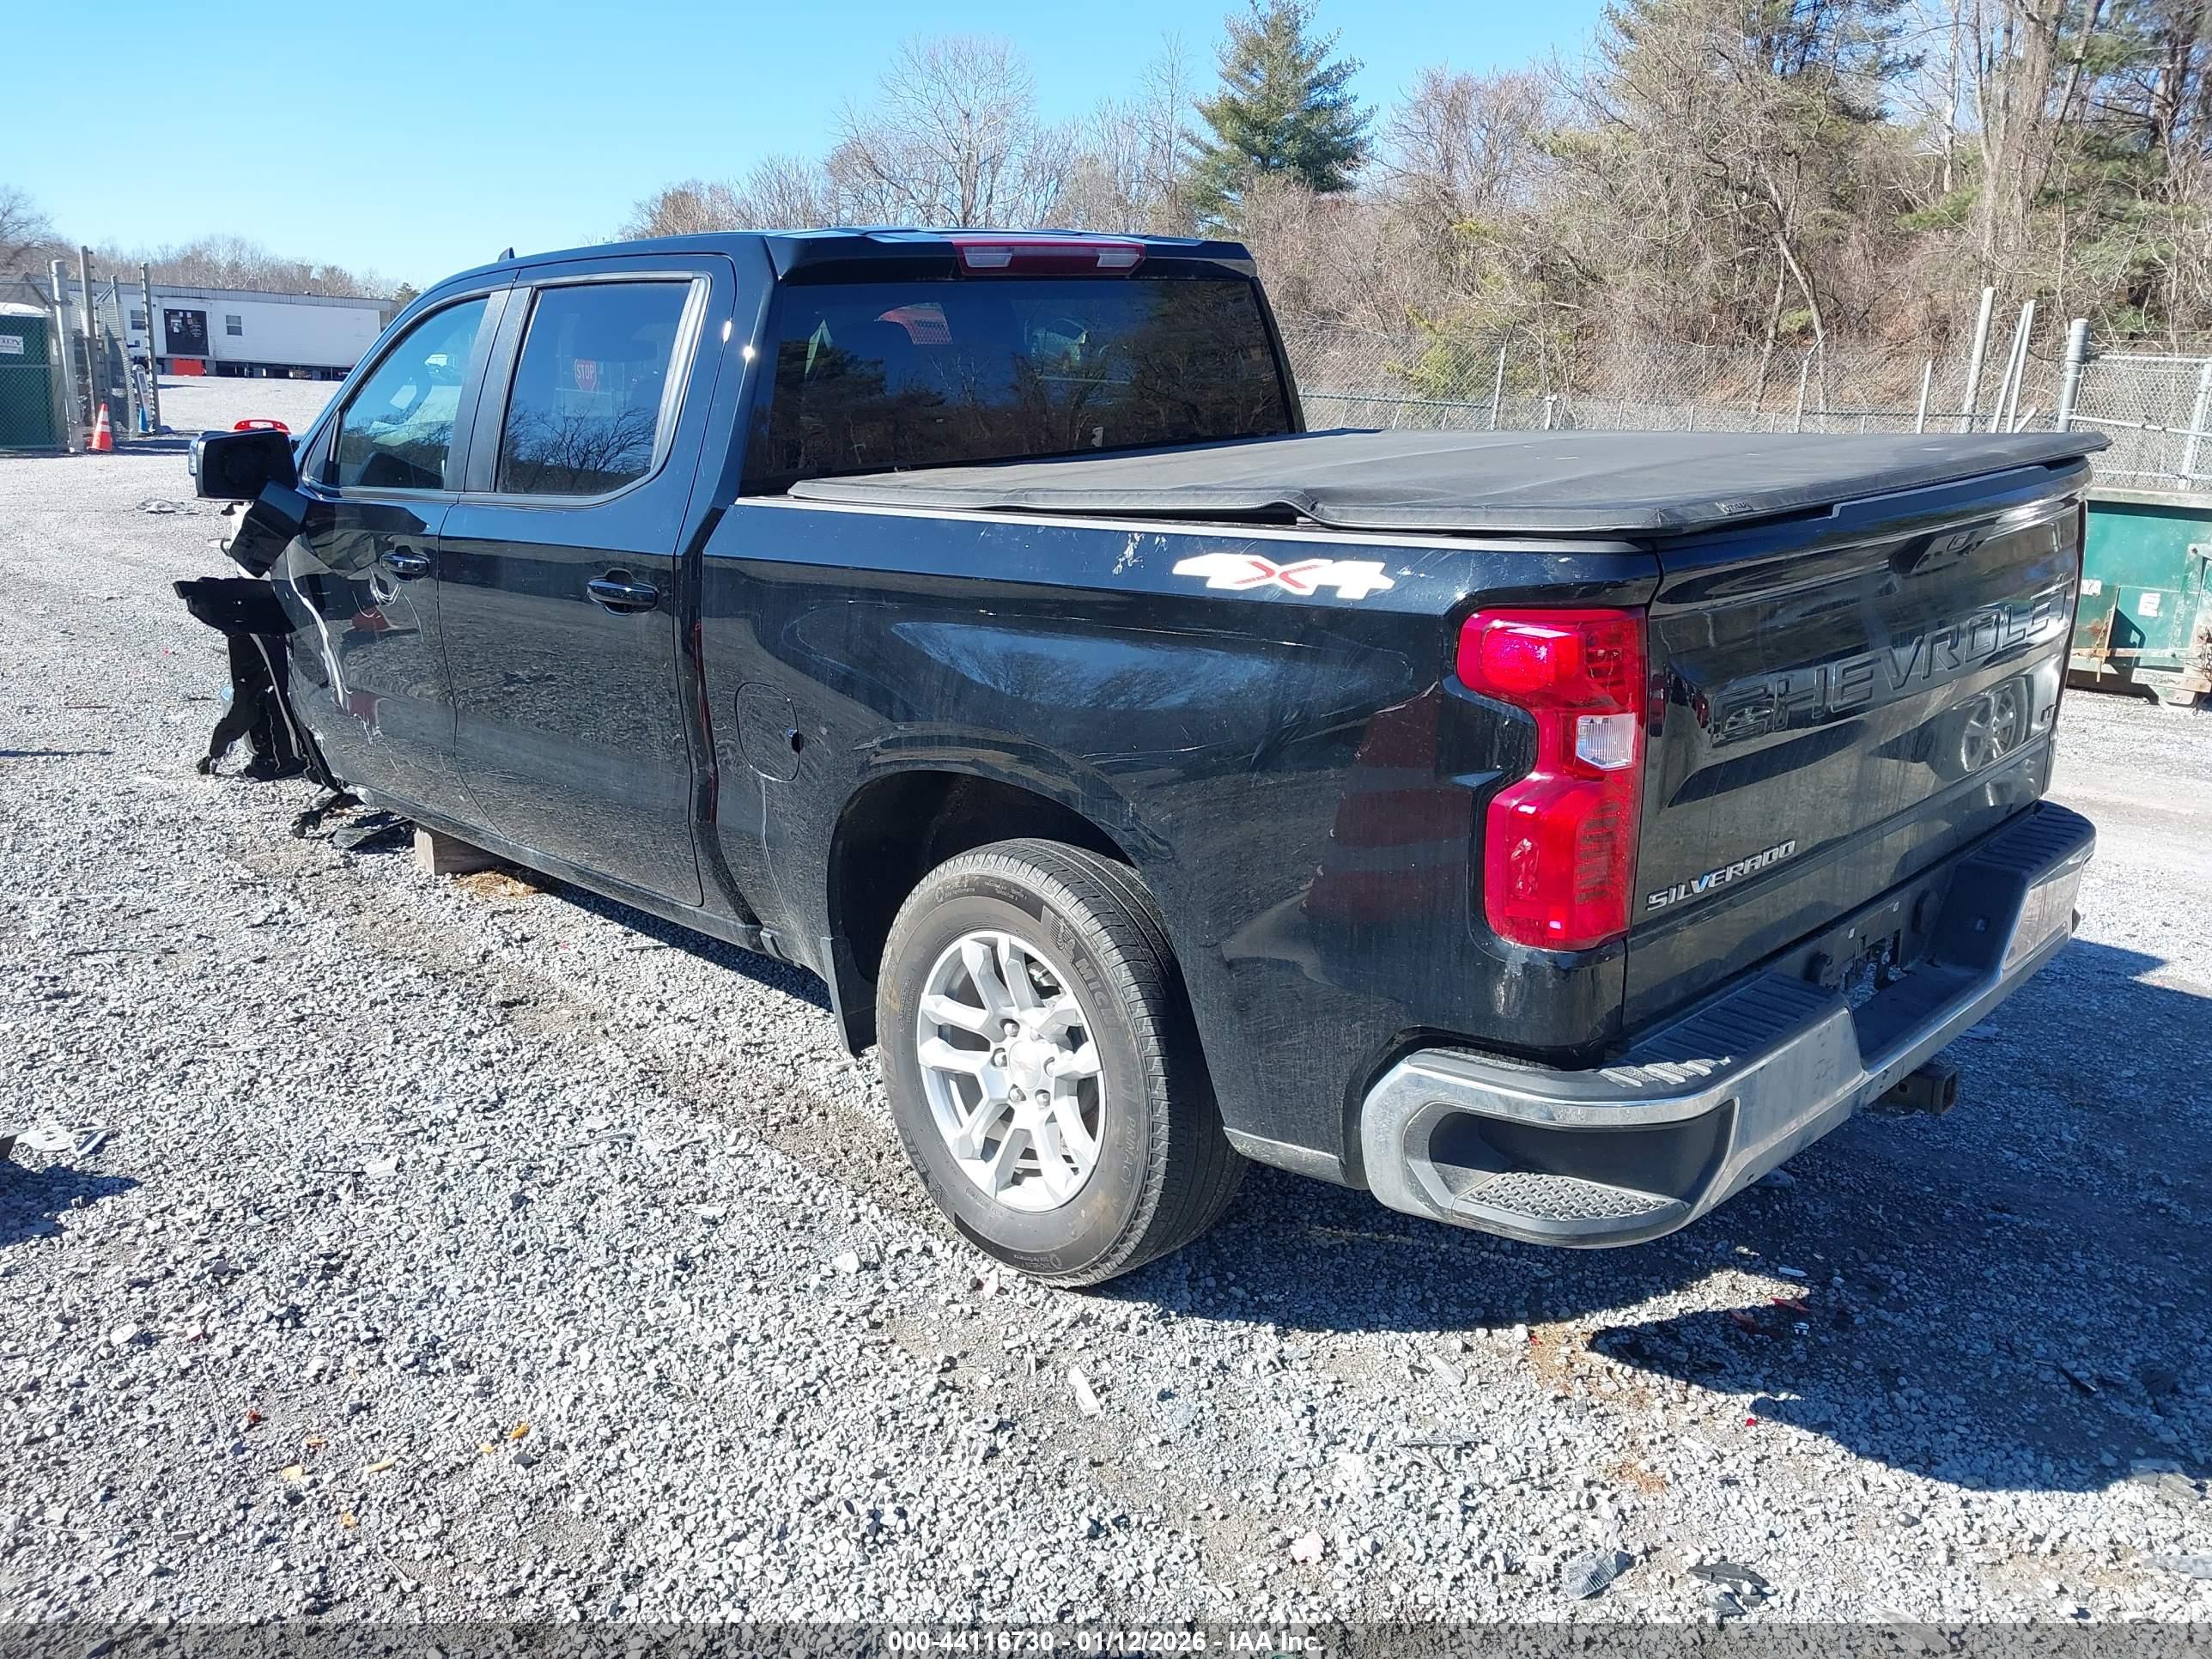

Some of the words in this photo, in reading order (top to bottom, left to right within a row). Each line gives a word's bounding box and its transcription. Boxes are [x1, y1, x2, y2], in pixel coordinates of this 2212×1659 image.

[576, 364, 595, 380] STOP
[1710, 580, 2075, 747] CHEVROLET
[1646, 839, 1796, 912] SILVERADO
[1120, 1115, 1137, 1189] PRIMACY
